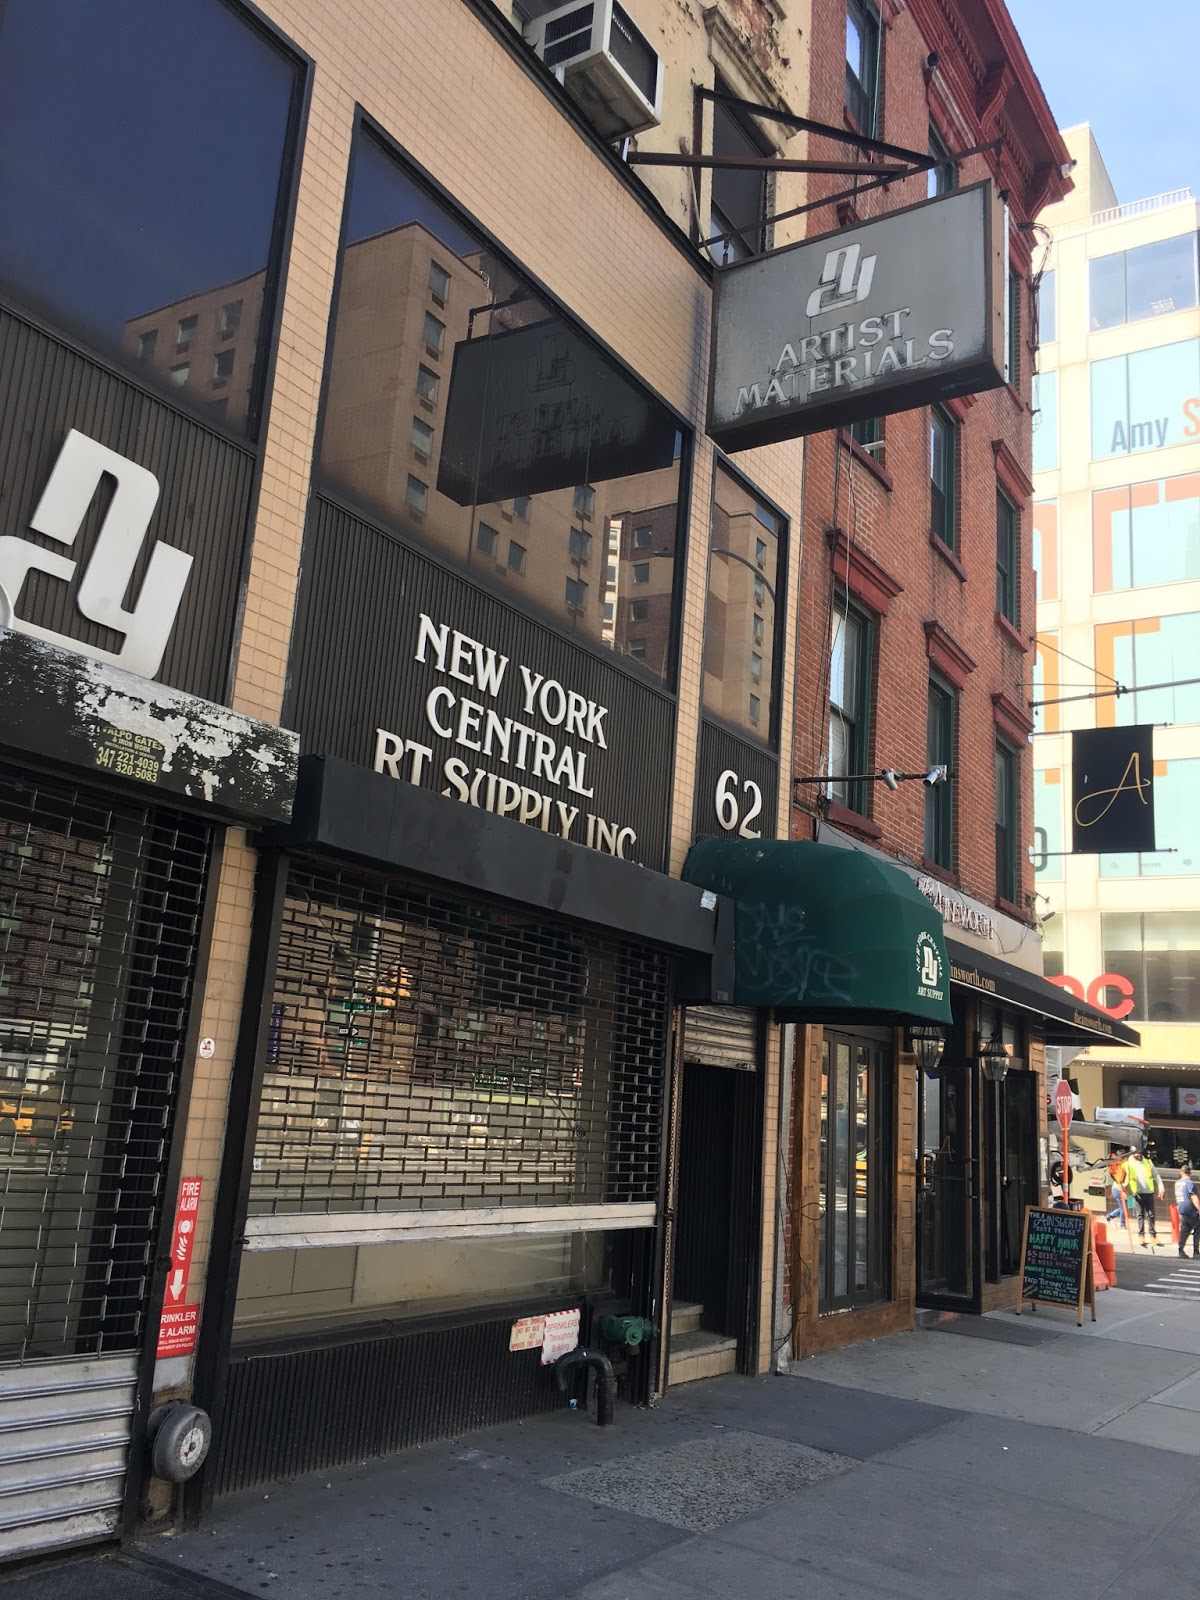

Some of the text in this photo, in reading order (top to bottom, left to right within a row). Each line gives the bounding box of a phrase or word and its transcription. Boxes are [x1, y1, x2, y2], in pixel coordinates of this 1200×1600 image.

[770, 306, 911, 375] ARTIST
[732, 328, 955, 416] MATERIALS
[1110, 417, 1169, 453] Amy
[414, 613, 608, 750] NEW YORK
[426, 686, 594, 798] CENTRAL
[117, 750, 159, 772] 221-4039
[115, 761, 158, 783] 320-5083
[715, 769, 762, 840] 62
[1056, 1096, 1071, 1114] STOP
[181, 1182, 200, 1196] FIRE
[180, 1196, 198, 1212] ALARM
[1029, 1233, 1079, 1250] HAPPY HOUR
[1023, 1276, 1039, 1285] TACO
[166, 1325, 196, 1338] ALARM
[547, 1319, 578, 1332] SPRINKLERS
[552, 1343, 570, 1353] Building
